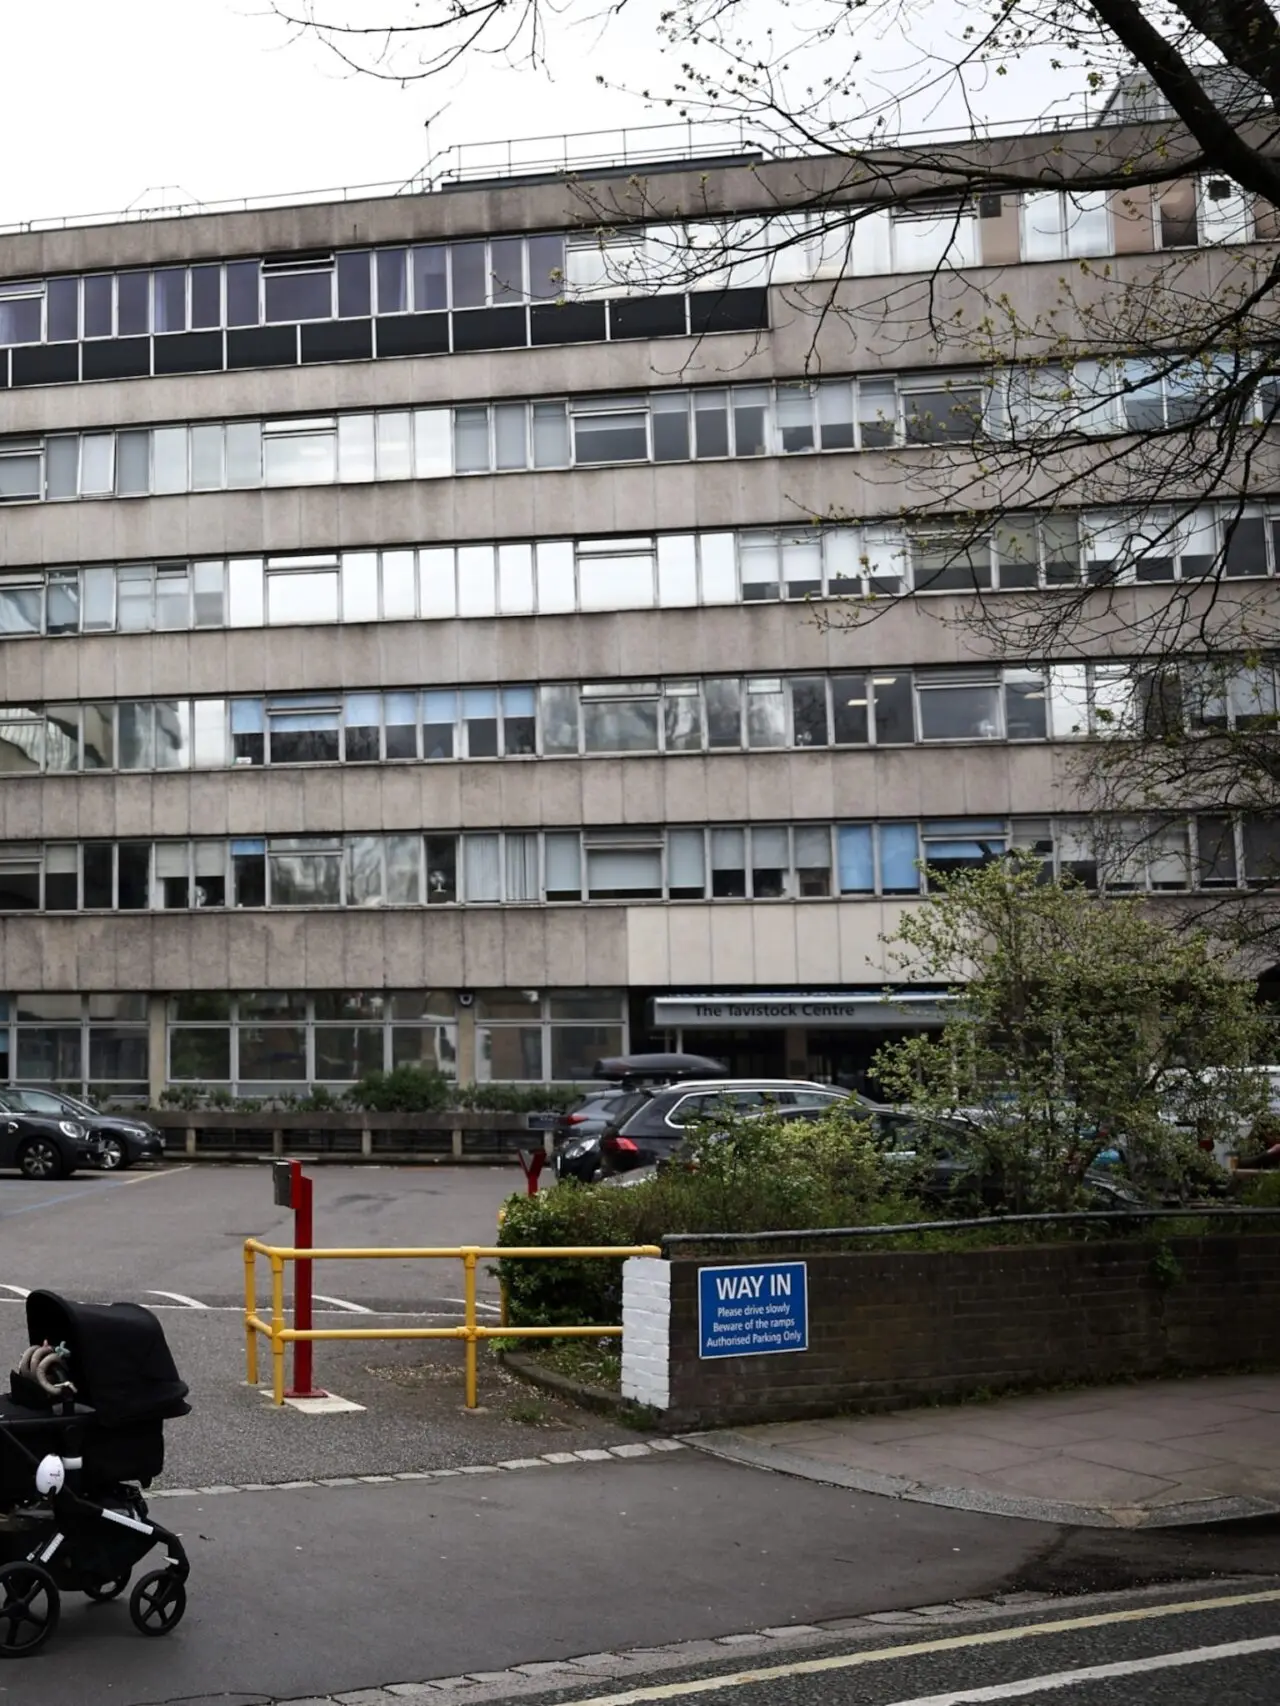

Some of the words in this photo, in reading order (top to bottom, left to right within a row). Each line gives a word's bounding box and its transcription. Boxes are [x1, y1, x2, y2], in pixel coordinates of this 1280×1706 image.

[694, 1005, 723, 1017] The
[728, 1004, 798, 1017] Tavistock
[801, 1004, 855, 1017] Centre
[716, 1274, 765, 1301] WAY
[770, 1273, 792, 1297] IN
[717, 1306, 743, 1317] Please
[744, 1304, 764, 1315] drive
[765, 1302, 791, 1315] slowly
[713, 1322, 742, 1332] Beware
[744, 1319, 753, 1330] of
[755, 1319, 769, 1329] the
[770, 1317, 795, 1328] ramps
[706, 1334, 751, 1348] Authorised
[752, 1332, 781, 1344] Parking
[783, 1329, 802, 1342] Only
